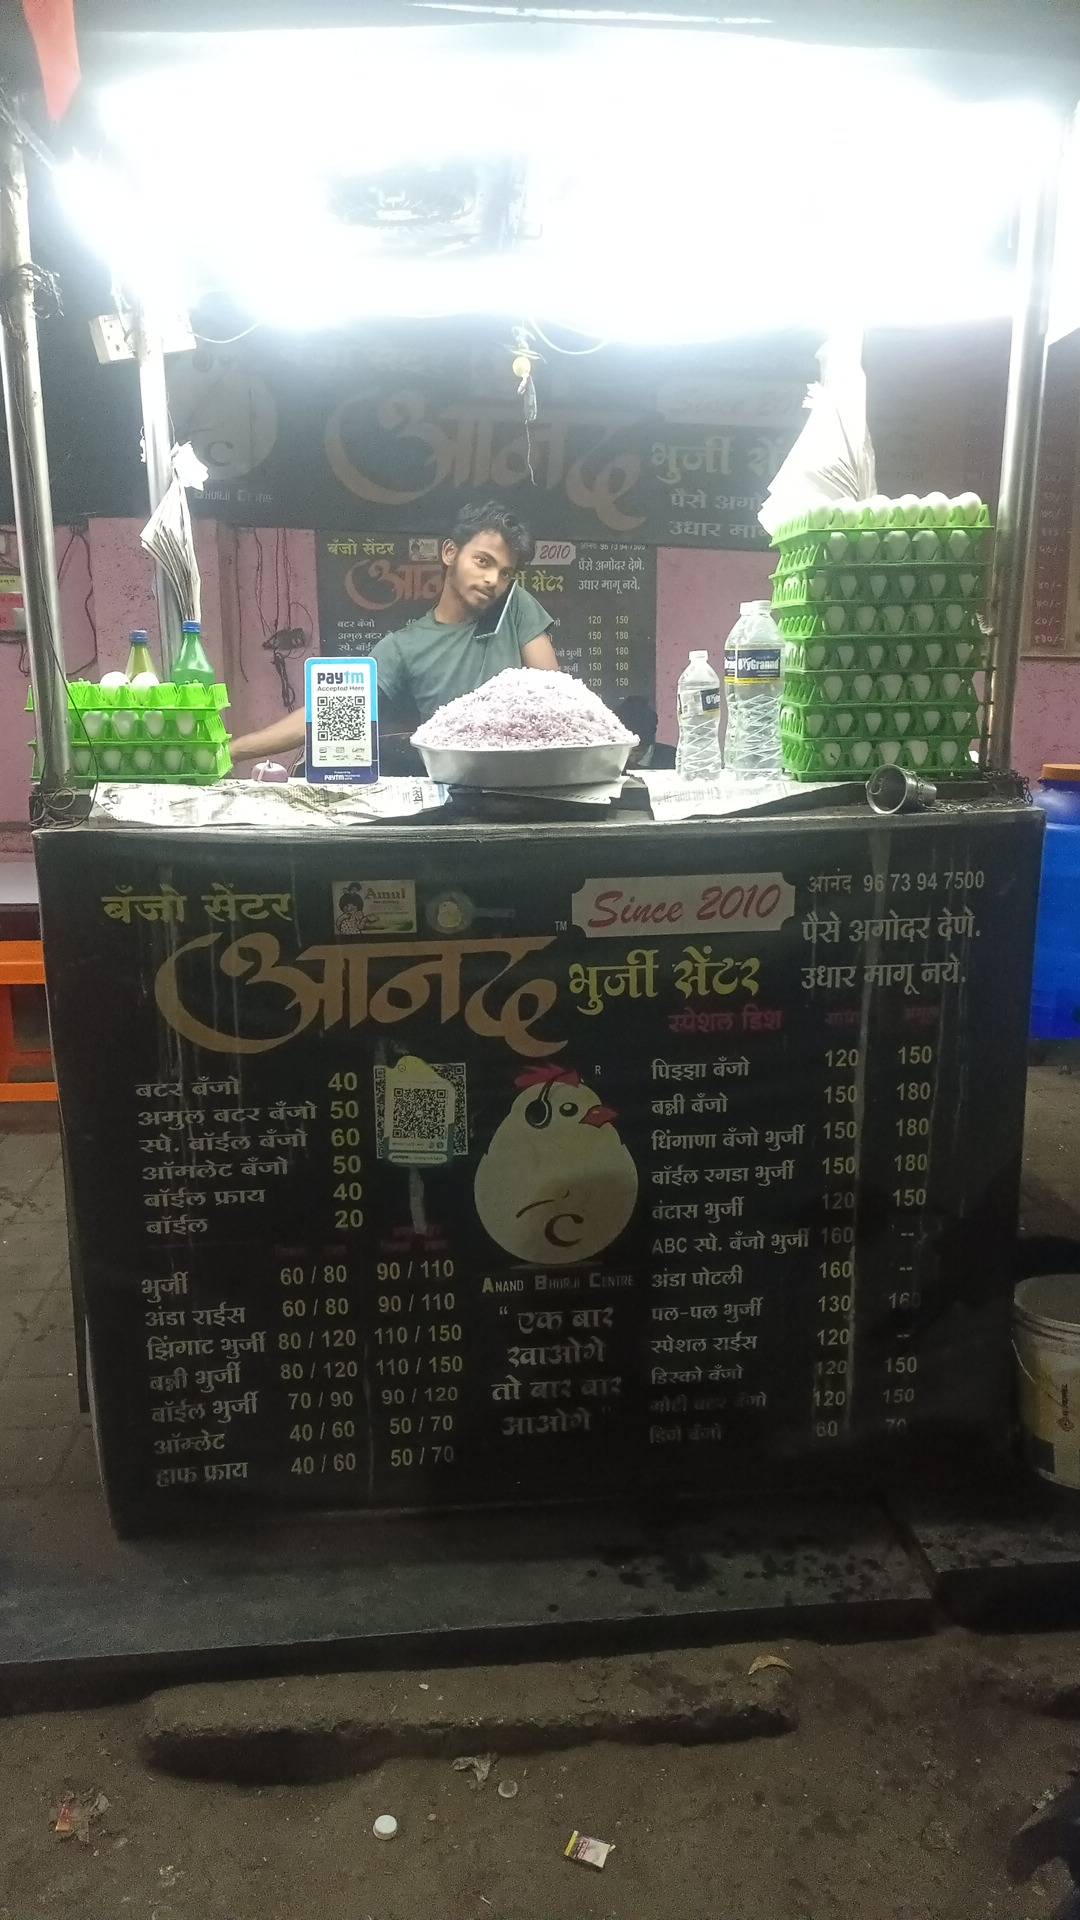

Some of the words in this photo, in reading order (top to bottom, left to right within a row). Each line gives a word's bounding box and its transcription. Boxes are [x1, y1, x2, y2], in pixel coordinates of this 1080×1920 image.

[540, 543, 571, 560] 2010
[588, 615, 602, 624] 120
[615, 615, 629, 624] 150
[588, 678, 602, 687] 120
[615, 678, 629, 687] 150
[365, 887, 406, 900] Amul
[808, 868, 852, 892] आनंद
[863, 873, 884, 891] 96
[891, 872, 911, 891] 73
[917, 872, 938, 890] 94
[944, 871, 985, 890] 7500
[201, 882, 293, 922] सेंटर
[588, 890, 683, 928] Since
[697, 884, 781, 920] 2010
[555, 920, 568, 931] TM
[801, 911, 841, 943] पैसे
[848, 908, 931, 942] अगोदर
[937, 908, 982, 940] देणे.
[568, 947, 661, 1015] भुर्जी
[673, 945, 761, 999] सेंटर
[801, 964, 857, 990] उधार
[864, 961, 920, 995] मागू
[922, 954, 967, 985] नये.
[668, 1006, 734, 1034] स्पेशल
[743, 1003, 783, 1031] डिश
[594, 1064, 602, 1076] R
[825, 1049, 859, 1068] 120
[897, 1046, 932, 1065] 150
[134, 1082, 184, 1098] बटर
[328, 1072, 358, 1092] 40
[824, 1085, 858, 1104] 150
[896, 1082, 931, 1100] 180
[136, 1108, 206, 1131] अमुल
[213, 1107, 261, 1123] बटर
[330, 1100, 359, 1120] 50
[188, 1130, 252, 1152] बॉईल
[331, 1127, 360, 1147] 60
[764, 1123, 806, 1152] भुर्जी
[823, 1121, 857, 1140] 150
[896, 1118, 930, 1137] 180
[141, 1159, 233, 1182] ऑमलेट
[333, 1155, 362, 1175] 50
[651, 1164, 699, 1187] बॉईल
[703, 1166, 750, 1184] रगडा
[754, 1159, 797, 1187] भुर्जी
[822, 1156, 856, 1175] 150
[894, 1153, 928, 1172] 180
[143, 1187, 207, 1209] बॉईल
[213, 1188, 267, 1206] फ्राय
[333, 1181, 363, 1201] 40
[704, 1196, 745, 1224] भुर्जी
[821, 1191, 855, 1210] 120
[893, 1188, 927, 1207] 150
[145, 1214, 209, 1235] बॉईल
[334, 1209, 364, 1230] 20
[651, 1236, 688, 1254] ABC
[771, 1227, 811, 1254] भुर्जी
[821, 1226, 854, 1245] 160
[141, 1271, 189, 1304] भुर्जी
[652, 1267, 686, 1288] अंडा
[691, 1264, 744, 1287] पोटली
[819, 1260, 852, 1279] 160
[145, 1305, 185, 1328] अंडा
[192, 1300, 246, 1328] राईस
[516, 1310, 564, 1335] एक
[570, 1306, 615, 1329] बार
[723, 1296, 765, 1324] भुर्जी
[818, 1294, 851, 1313] 130
[147, 1334, 214, 1362] झिंगाट
[220, 1331, 268, 1360] भुर्जी
[506, 1335, 606, 1369] खाओगे
[650, 1333, 707, 1355] स्पेशल
[712, 1330, 759, 1352] राईस
[817, 1328, 851, 1346] 120
[195, 1361, 243, 1394] भुर्जी
[651, 1365, 704, 1386] डिस्को
[816, 1359, 848, 1375] 120
[885, 1356, 918, 1374] 150
[490, 1374, 523, 1401] तो
[528, 1378, 572, 1400] बार
[581, 1376, 622, 1398] बार
[813, 1390, 846, 1407] 120
[883, 1388, 916, 1404] 150
[212, 1390, 260, 1424] भुर्जी
[502, 1406, 592, 1436] आओगे
[816, 1420, 839, 1438] 60
